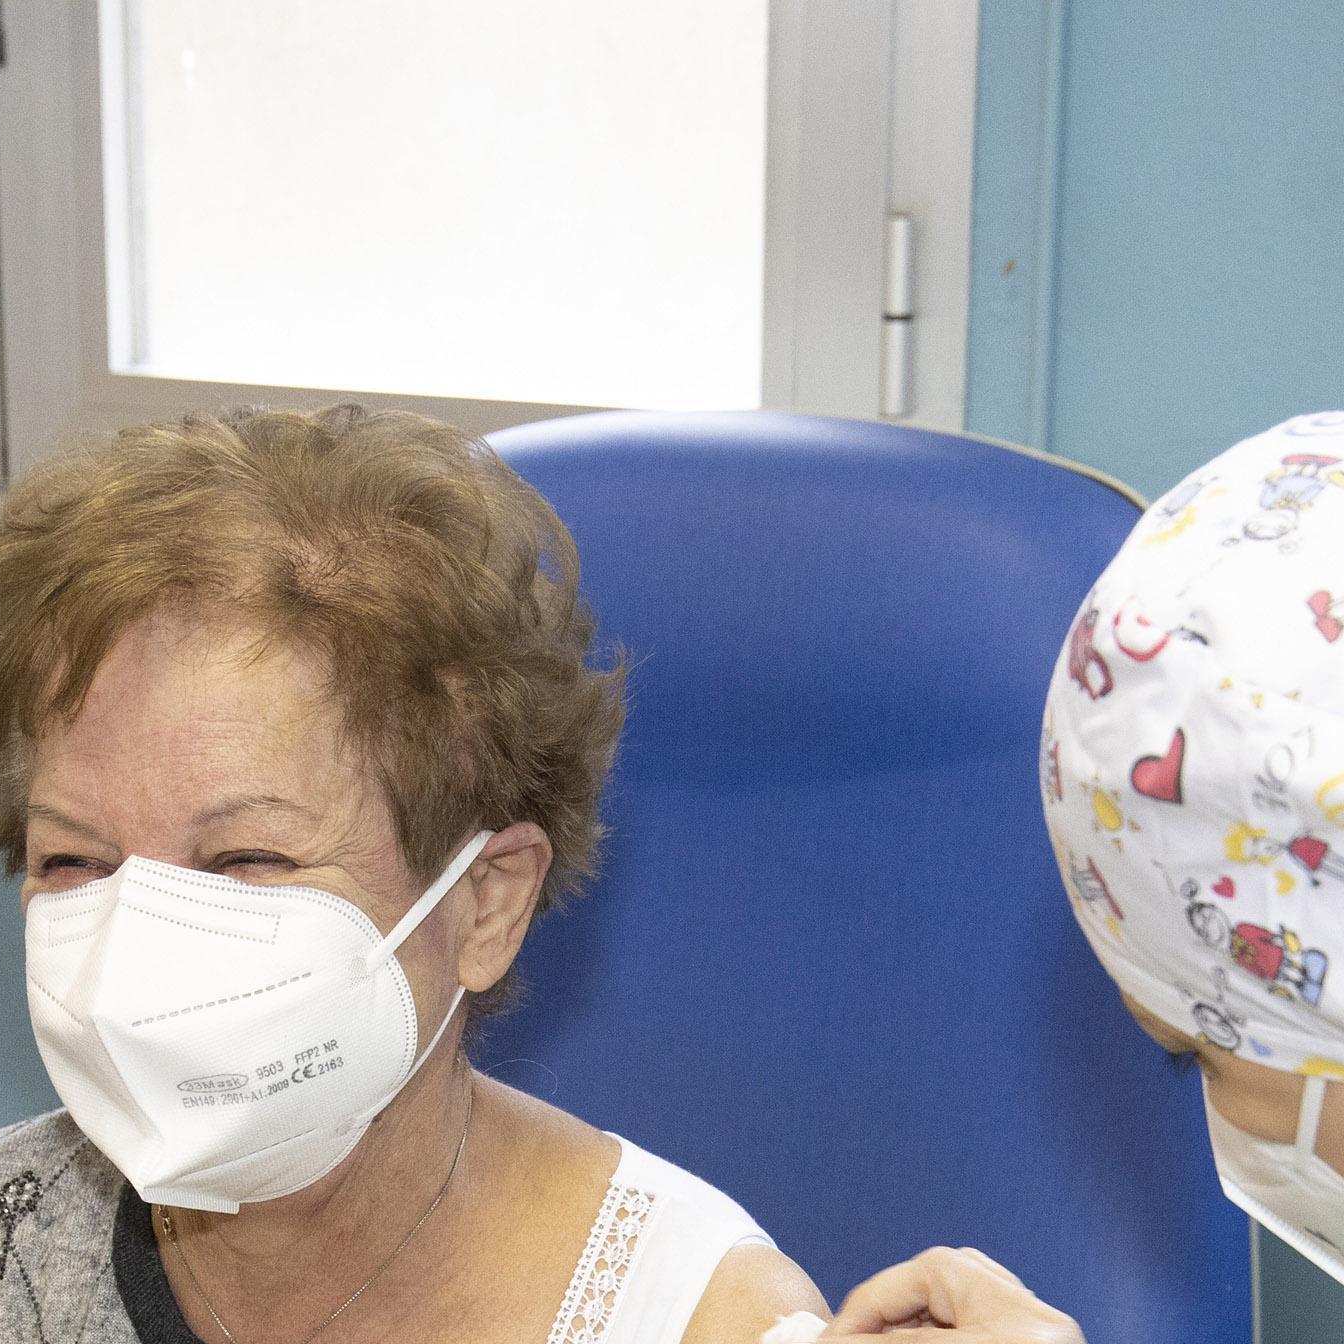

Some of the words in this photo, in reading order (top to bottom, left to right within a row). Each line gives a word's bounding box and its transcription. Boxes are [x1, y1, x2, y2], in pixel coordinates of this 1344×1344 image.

[255, 1060, 285, 1080] 9503
[294, 1046, 321, 1065] FFP2
[323, 1039, 339, 1053] NR
[318, 1057, 344, 1075] 2163
